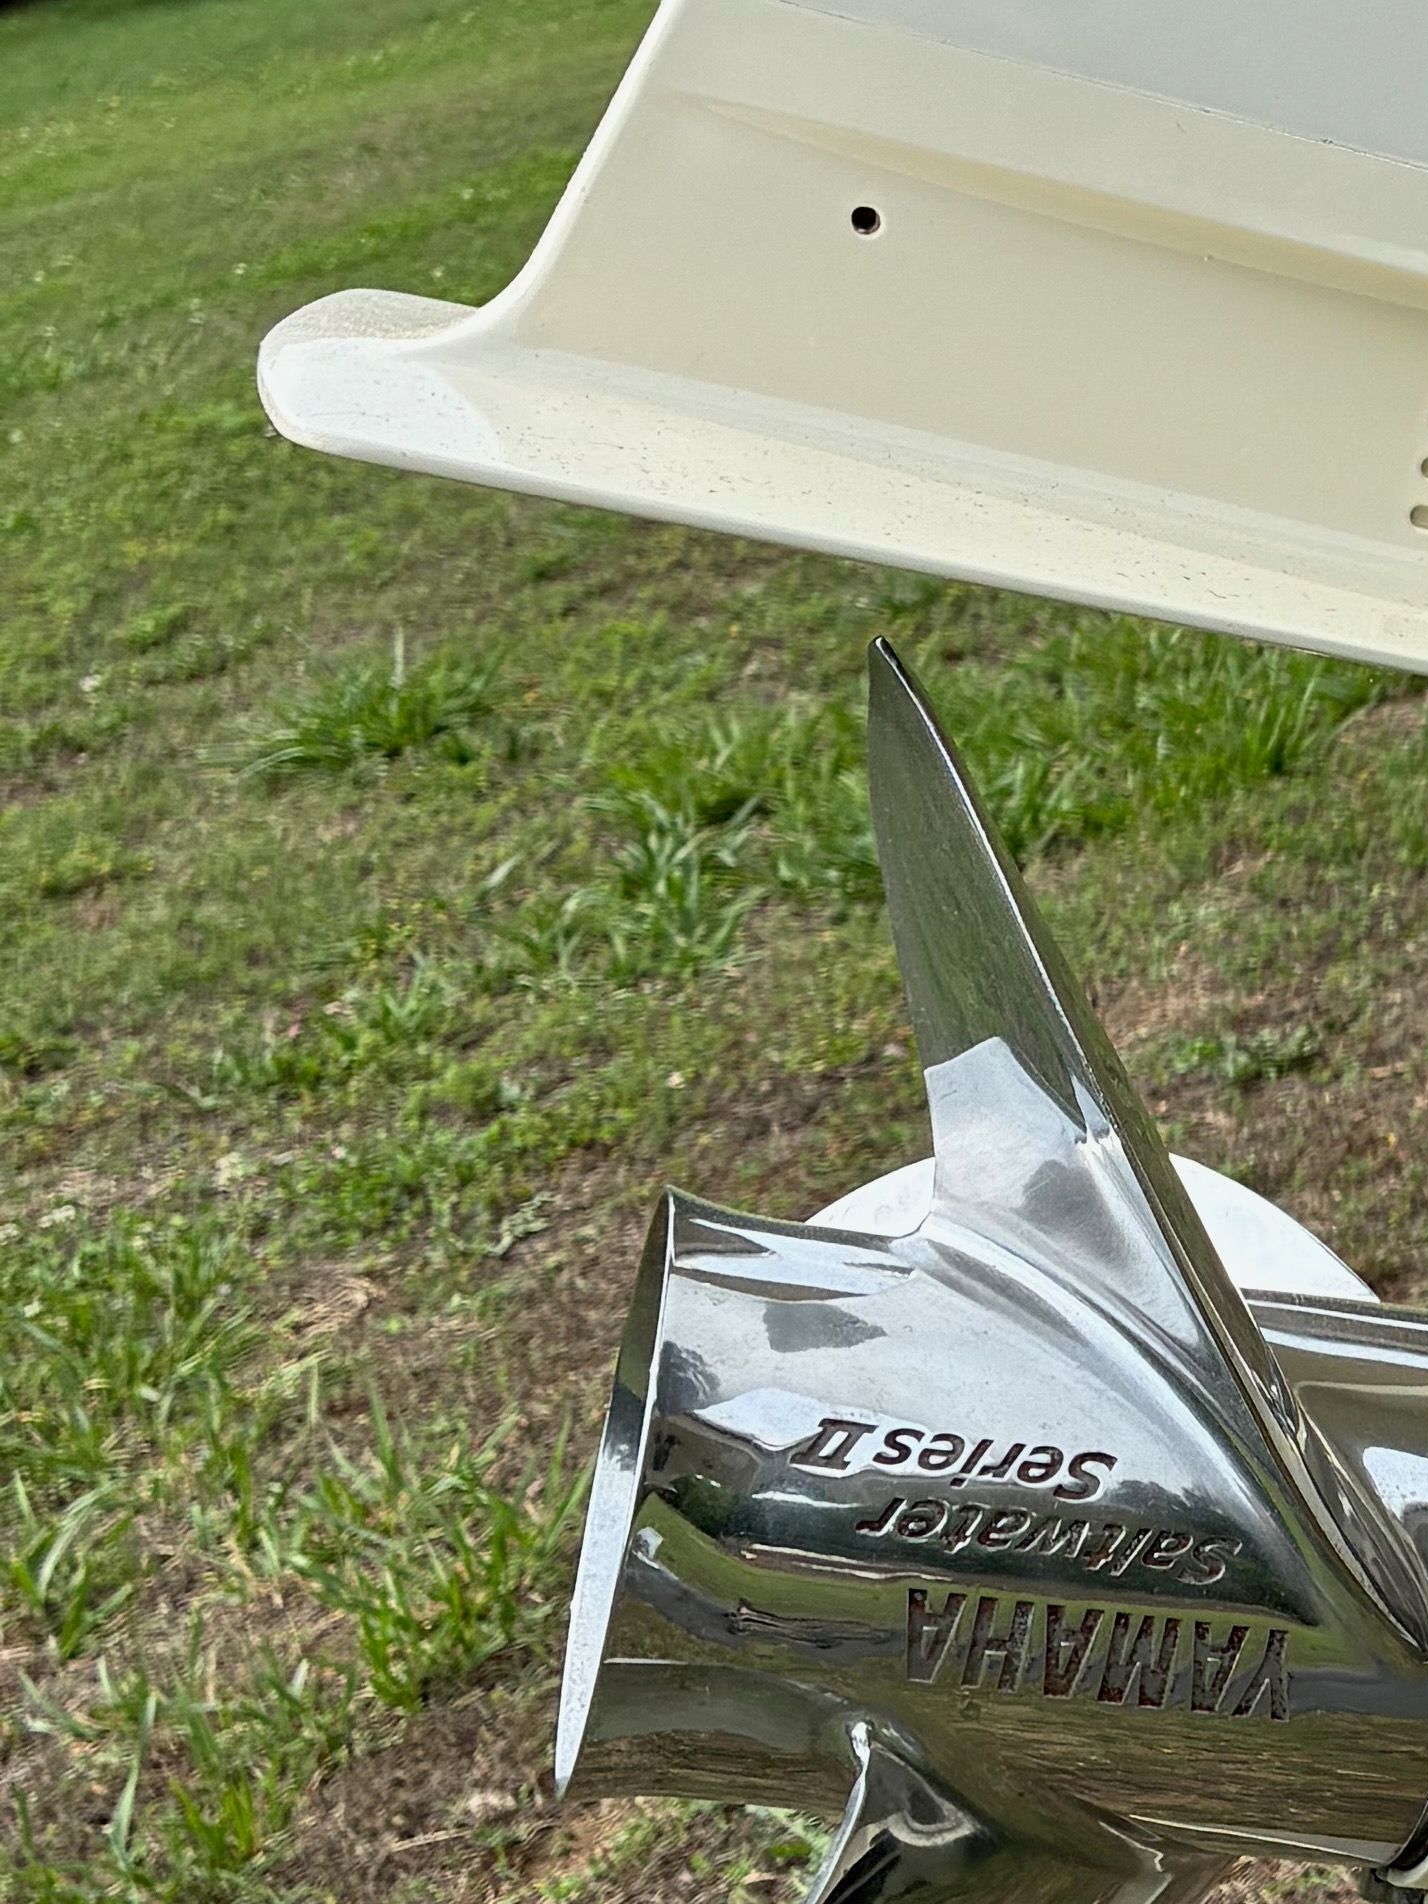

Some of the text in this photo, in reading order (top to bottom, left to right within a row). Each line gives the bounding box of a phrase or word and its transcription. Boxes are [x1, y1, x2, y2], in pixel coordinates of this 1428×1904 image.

[788, 1416, 1118, 1503] Series II
[855, 1497, 1243, 1587] Saltwater
[904, 1586, 1290, 1723] YAMAHA
